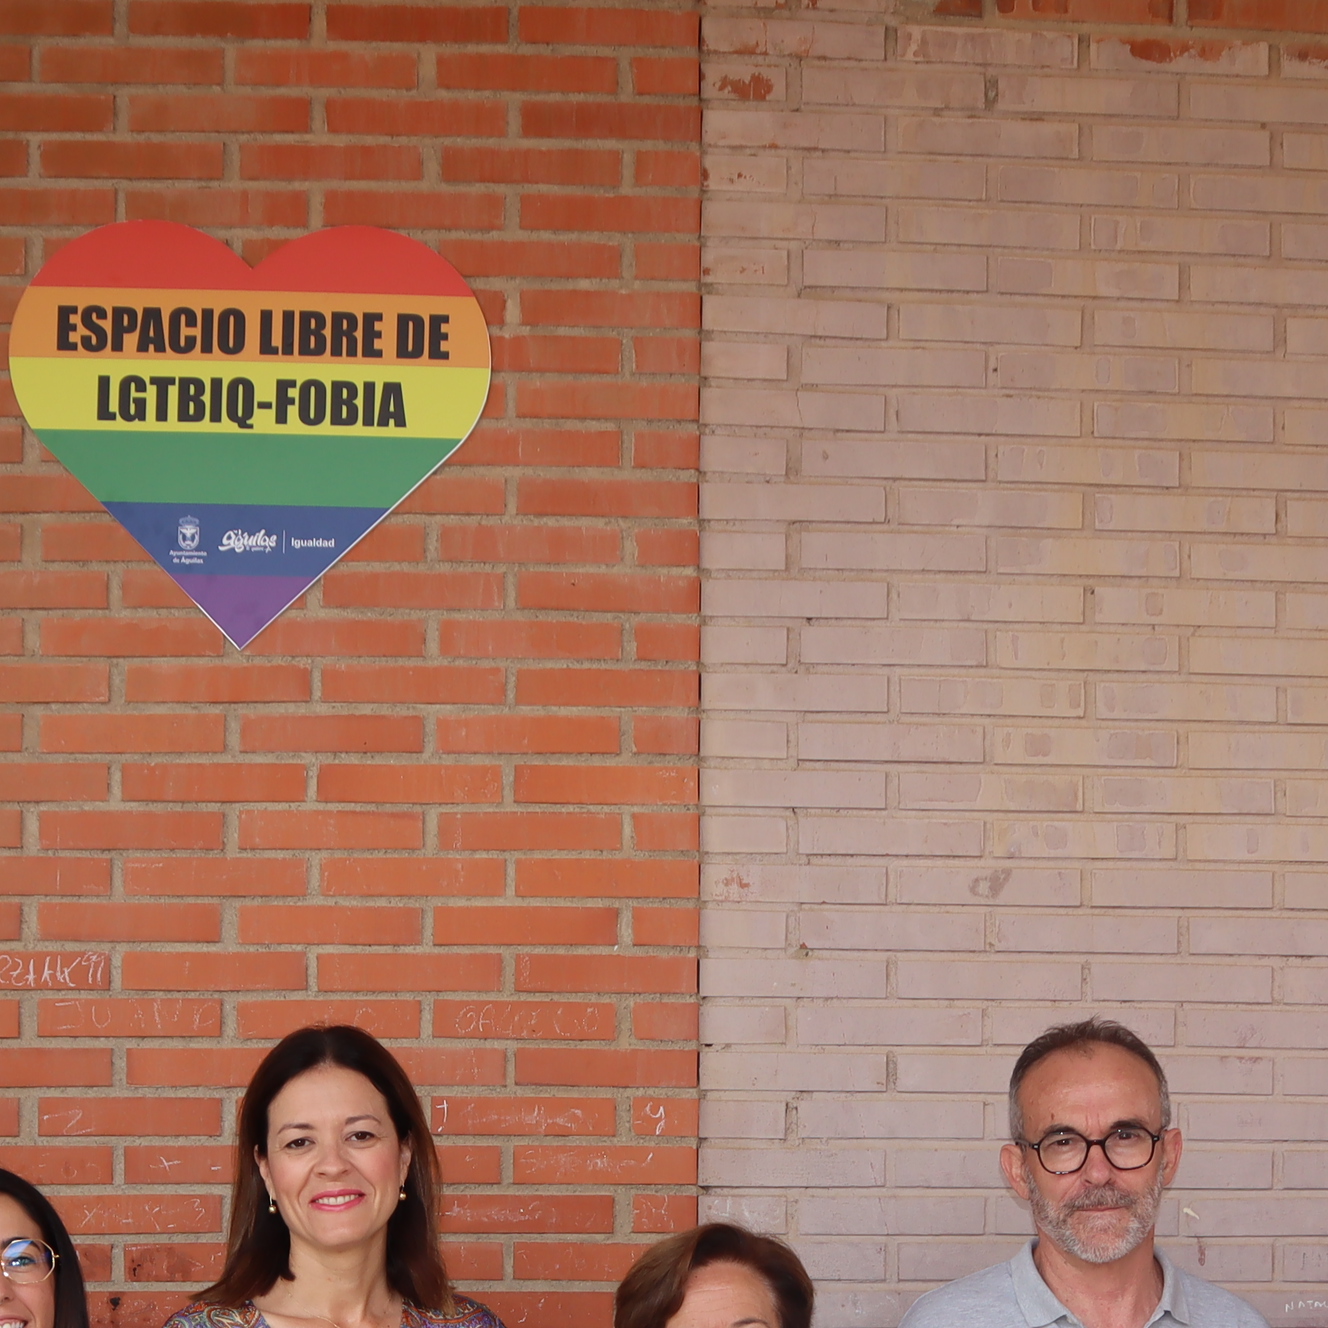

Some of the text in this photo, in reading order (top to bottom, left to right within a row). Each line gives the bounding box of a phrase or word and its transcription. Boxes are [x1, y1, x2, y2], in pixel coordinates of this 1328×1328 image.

[55, 304, 450, 360] ESPACIO LIBRE DE
[96, 374, 407, 429] LGTBIQ-FOBIA
[291, 537, 335, 549] Igualdad
